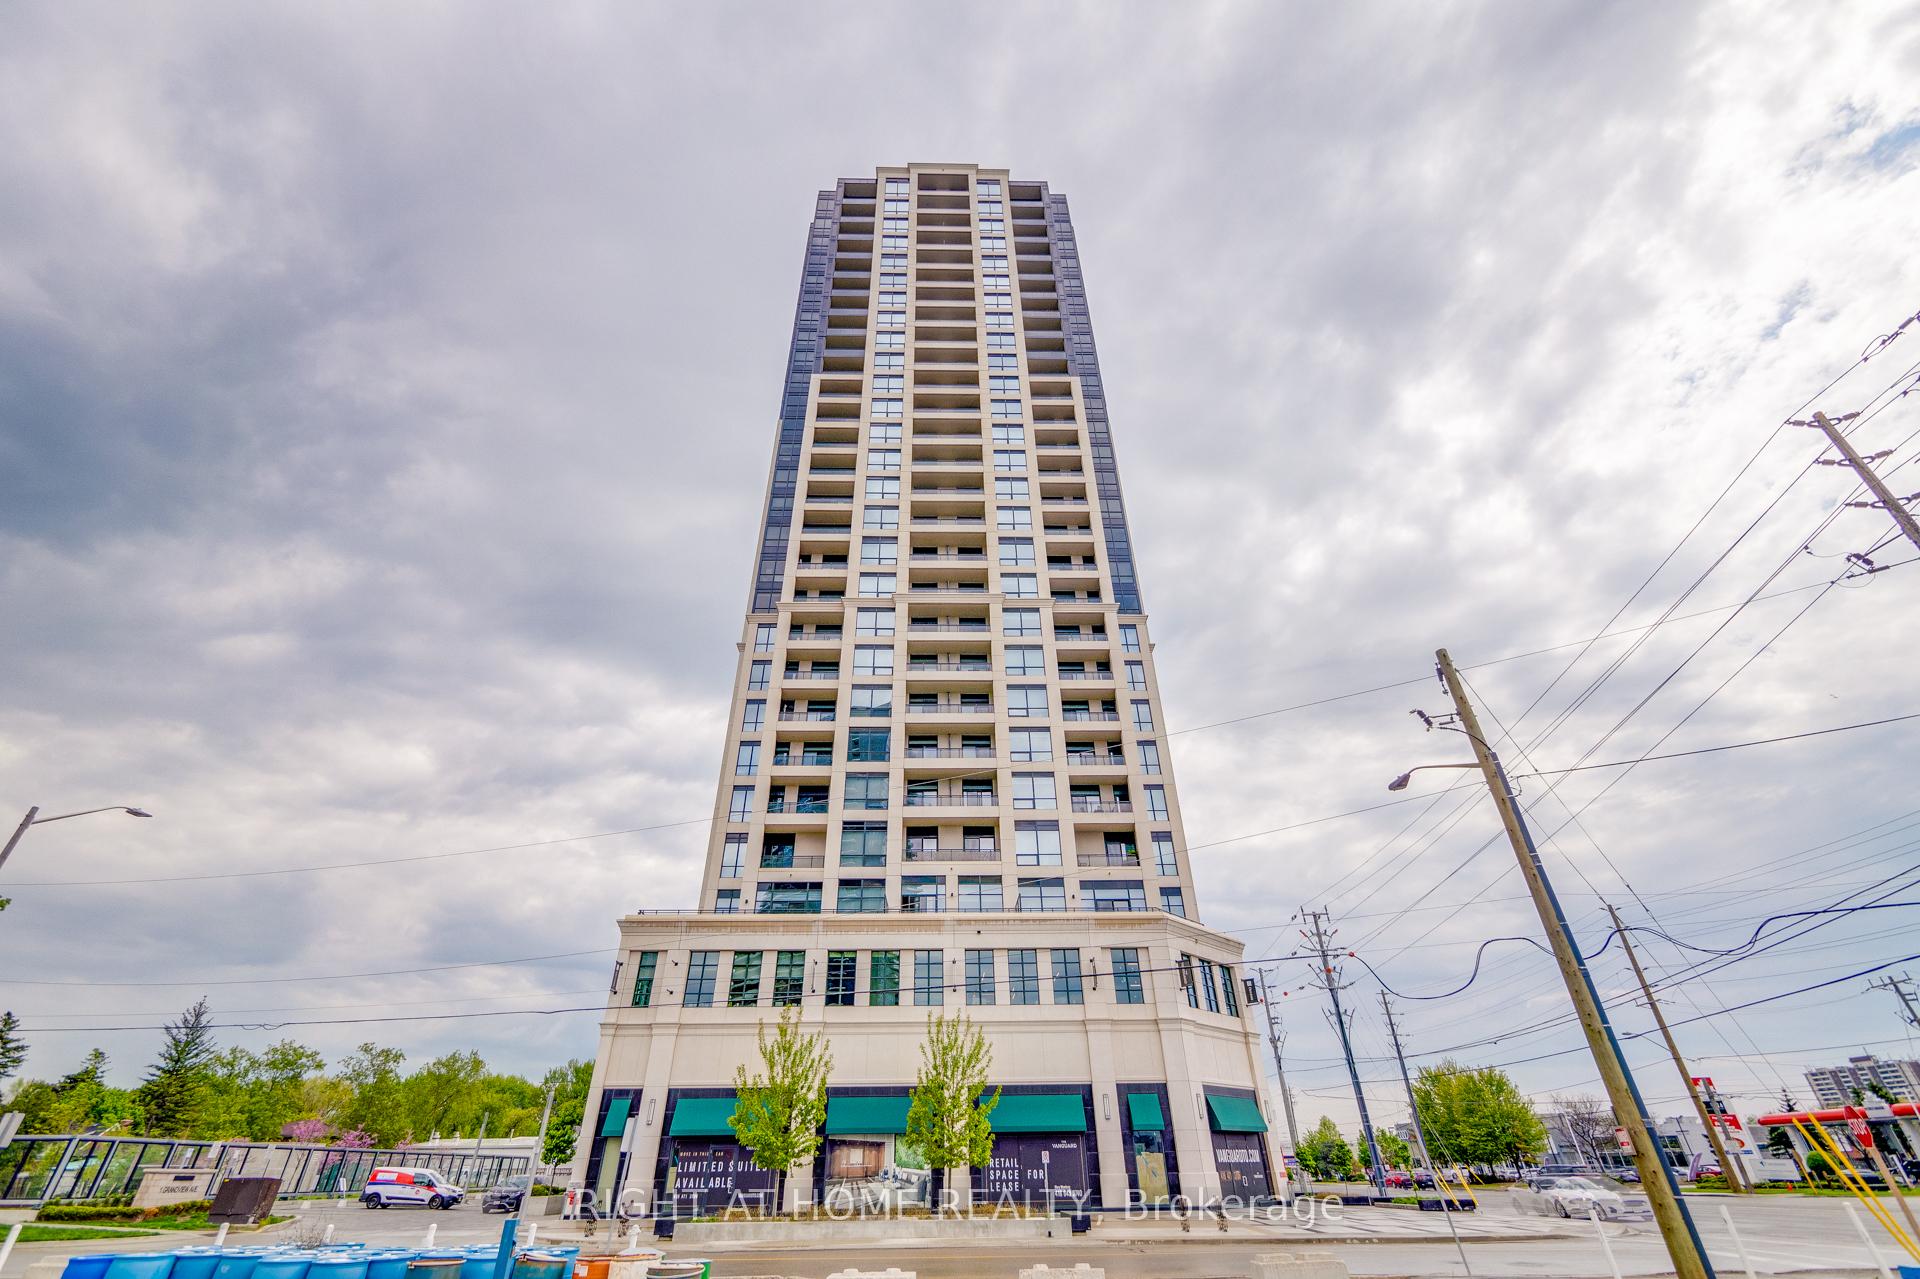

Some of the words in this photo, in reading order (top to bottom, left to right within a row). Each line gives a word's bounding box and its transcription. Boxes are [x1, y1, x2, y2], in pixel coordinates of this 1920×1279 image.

[1848, 1118, 1868, 1135] STOP
[677, 1161, 724, 1173] LIMITED
[989, 1157, 1019, 1168] RETAIL
[989, 1169, 1020, 1180] SPACE
[1027, 1169, 1045, 1180] FOR
[674, 1177, 733, 1189] AVAILABLE
[989, 1181, 1020, 1192] LEASE
